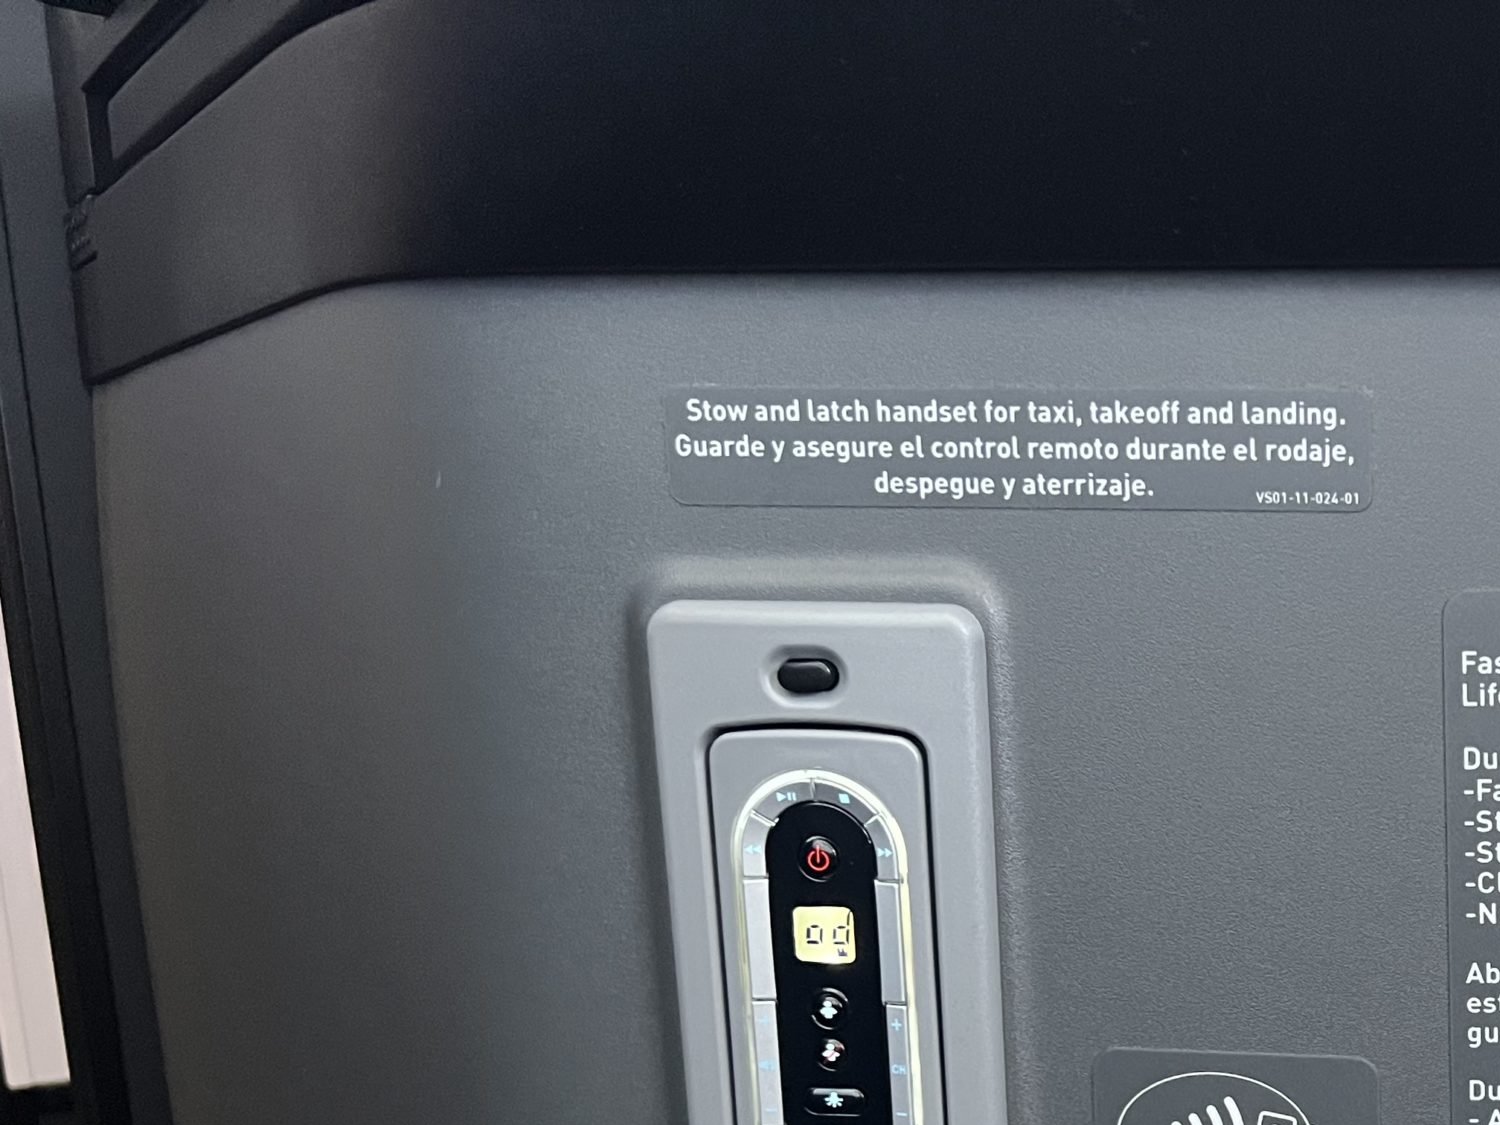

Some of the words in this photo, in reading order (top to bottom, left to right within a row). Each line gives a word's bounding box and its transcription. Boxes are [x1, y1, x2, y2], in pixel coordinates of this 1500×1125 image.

[685, 397, 748, 422] Stow
[754, 398, 801, 423] and
[806, 398, 870, 423] latch
[875, 398, 978, 423] handset
[983, 399, 1021, 424] for
[1027, 399, 1083, 428] taxi,
[1089, 399, 1180, 425] takeoff
[1186, 399, 1234, 425] and
[1241, 400, 1346, 432] landing.
[674, 433, 765, 458] Guarde
[771, 439, 786, 463] y
[792, 440, 893, 464] asegure
[899, 434, 925, 459] el
[930, 435, 1021, 459] control
[1027, 437, 1119, 461] remoto
[1125, 436, 1227, 462] durante
[1232, 436, 1258, 462] el
[1265, 437, 1355, 468] rodaje,
[874, 470, 995, 500] despegue
[1001, 477, 1016, 501] y
[1022, 472, 1154, 502] aterrizaje.
[1255, 490, 1360, 505] VS01-11-024-01
[891, 1064, 907, 1076] CH
